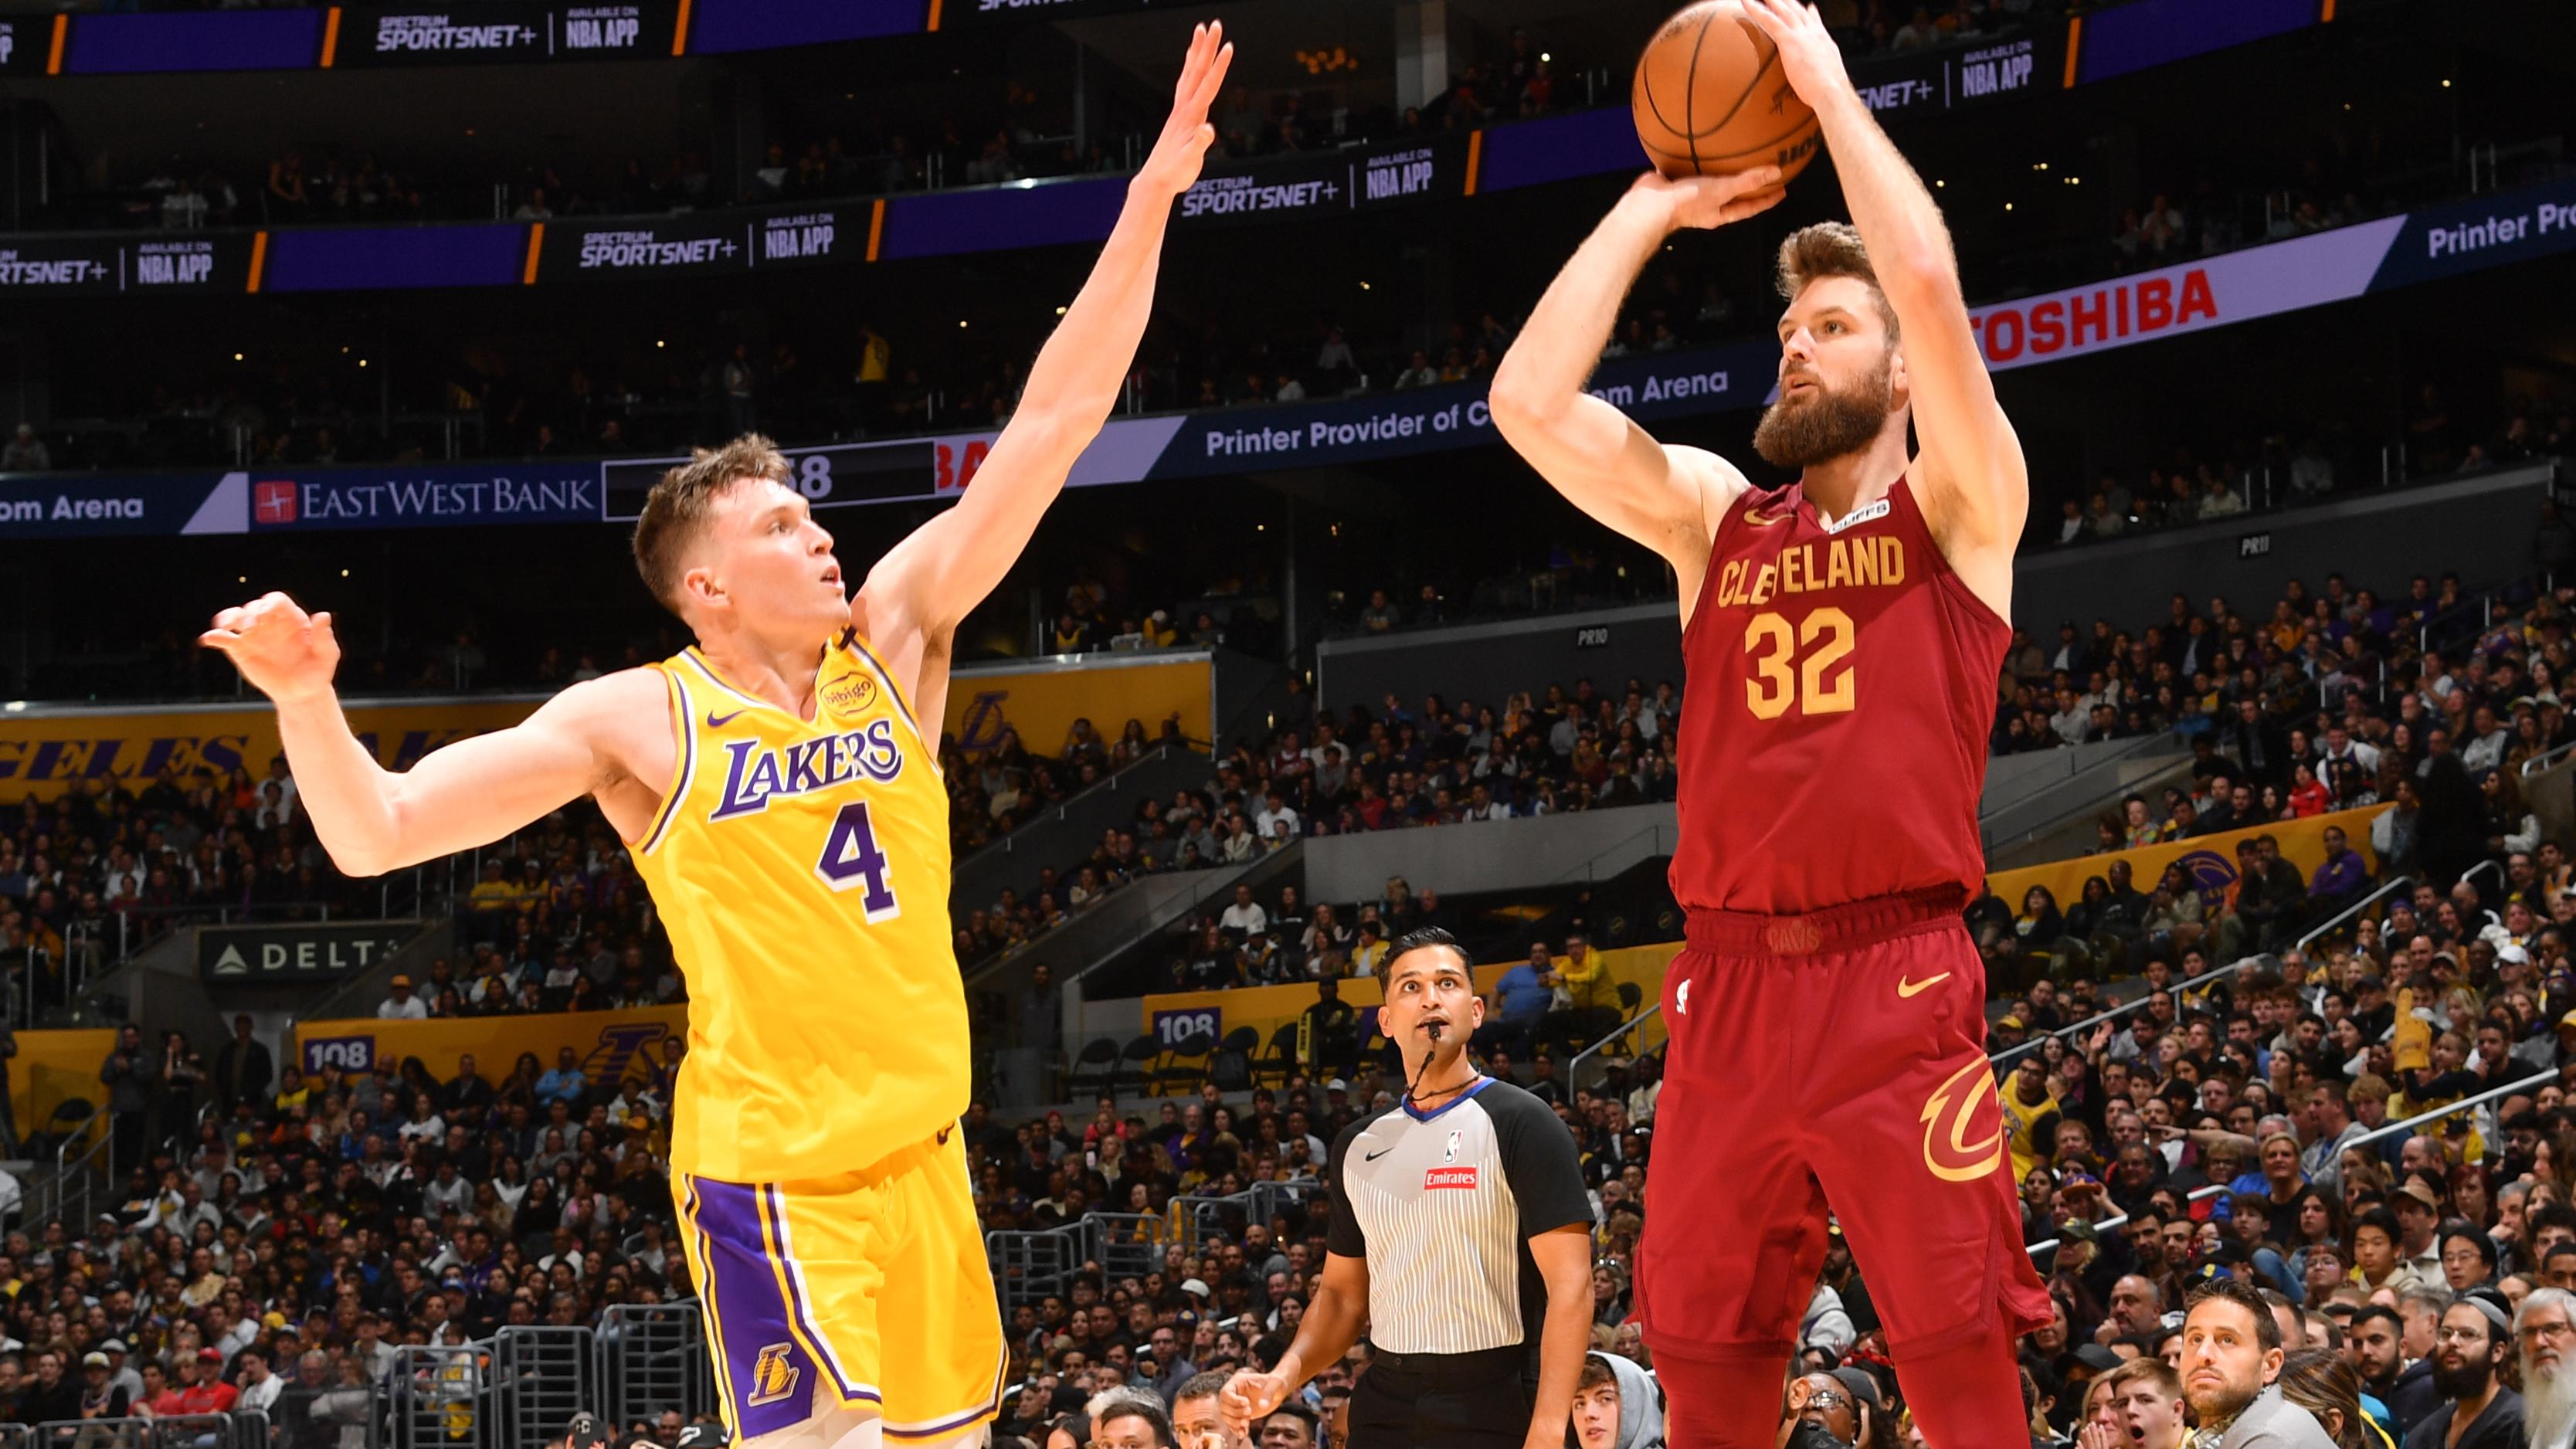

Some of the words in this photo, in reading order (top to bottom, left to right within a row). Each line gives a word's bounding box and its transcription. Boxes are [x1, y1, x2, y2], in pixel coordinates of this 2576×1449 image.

[375, 24, 538, 52] SPORTSNET+
[379, 15, 450, 27] SPECTRUM
[565, 20, 602, 49] NBA
[605, 19, 640, 48] APP
[1962, 61, 1998, 98] NBA
[2001, 53, 2033, 91] APP
[1366, 167, 1400, 200] NBA
[1401, 161, 1434, 195] APP
[1181, 180, 1339, 218] SPORTSNET+
[579, 238, 739, 268] SPORTSNET+
[582, 231, 655, 246] SPECTRUM
[765, 229, 800, 260] NBA
[801, 225, 835, 257] APP
[2428, 221, 2529, 259] Printer
[137, 254, 175, 285] NBA
[177, 253, 213, 284] APP
[1970, 269, 2217, 363] OSHIBA
[1207, 426, 1302, 457] Printer
[1310, 412, 1426, 448] Provider
[1432, 403, 1460, 433] of
[1641, 370, 1729, 402] Arena
[51, 494, 144, 521] Arena
[1744, 606, 1857, 721] 32
[823, 680, 871, 704] bibigo
[708, 715, 904, 825] LAKERS
[814, 799, 901, 925] 4
[1426, 1172, 1475, 1186] Emirates
